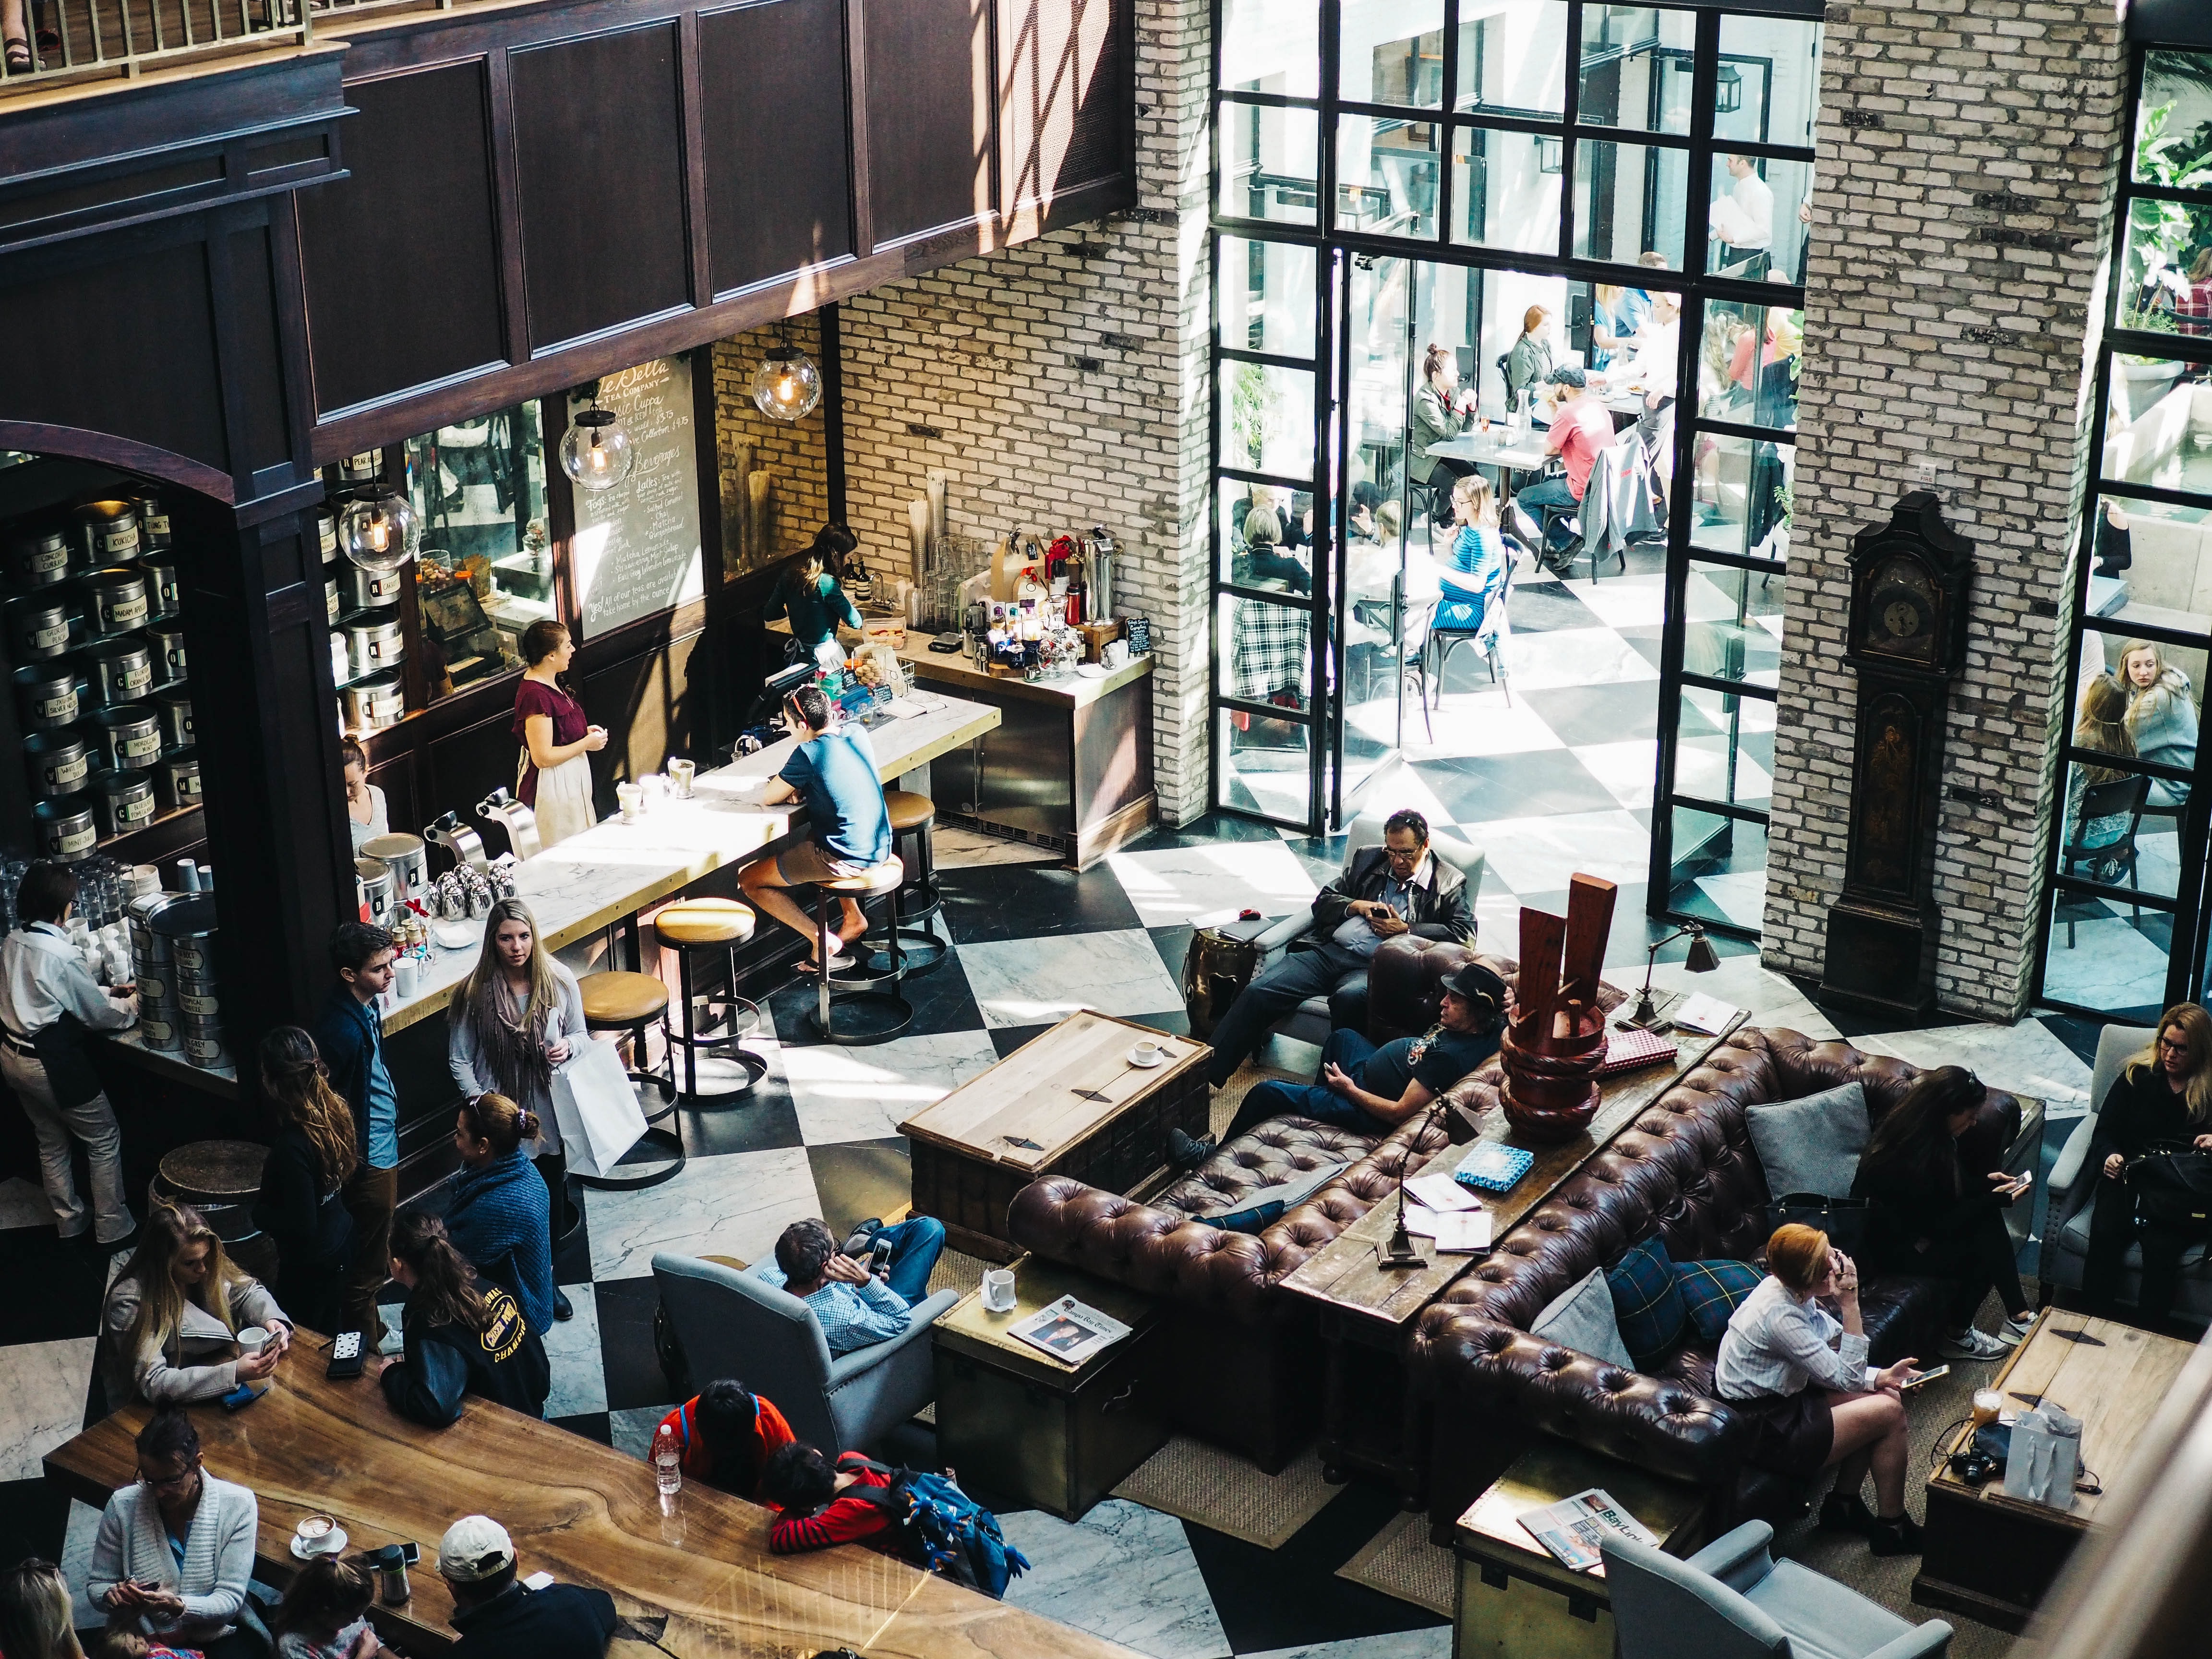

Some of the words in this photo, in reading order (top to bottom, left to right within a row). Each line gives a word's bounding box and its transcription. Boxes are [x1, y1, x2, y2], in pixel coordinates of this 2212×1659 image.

[604, 392, 621, 403] TEA
[623, 379, 660, 397] COMPANY
[634, 395, 664, 414] Cuppa
[343, 459, 350, 468] R
[354, 458, 366, 466] PEAR
[634, 445, 680, 476] Beverages
[637, 477, 661, 493] Lattes:
[661, 473, 670, 481] Tea
[647, 500, 663, 513] Salted
[655, 509, 669, 521] Chai
[652, 516, 676, 531] Matcha
[112, 533, 136, 546] KUKICHA
[616, 550, 641, 565] Matcha
[650, 551, 662, 561] Mint
[372, 584, 379, 593] R
[589, 596, 603, 623] Yes!
[613, 591, 621, 602] of
[620, 589, 631, 600] our
[633, 583, 645, 594] teas
[646, 579, 657, 589] are
[603, 606, 616, 617] take
[616, 601, 632, 613] home
[632, 598, 640, 608] by
[640, 594, 650, 603] the
[652, 585, 673, 599] ounce.
[114, 607, 133, 618] MADAM
[370, 646, 377, 656] R
[363, 705, 371, 715] R
[179, 782, 186, 792] M
[410, 873, 416, 884] B
[375, 901, 382, 912] B
[485, 1287, 503, 1304] ONAL
[1063, 1307, 1084, 1319] Tampa
[1094, 1322, 1112, 1334] Times
